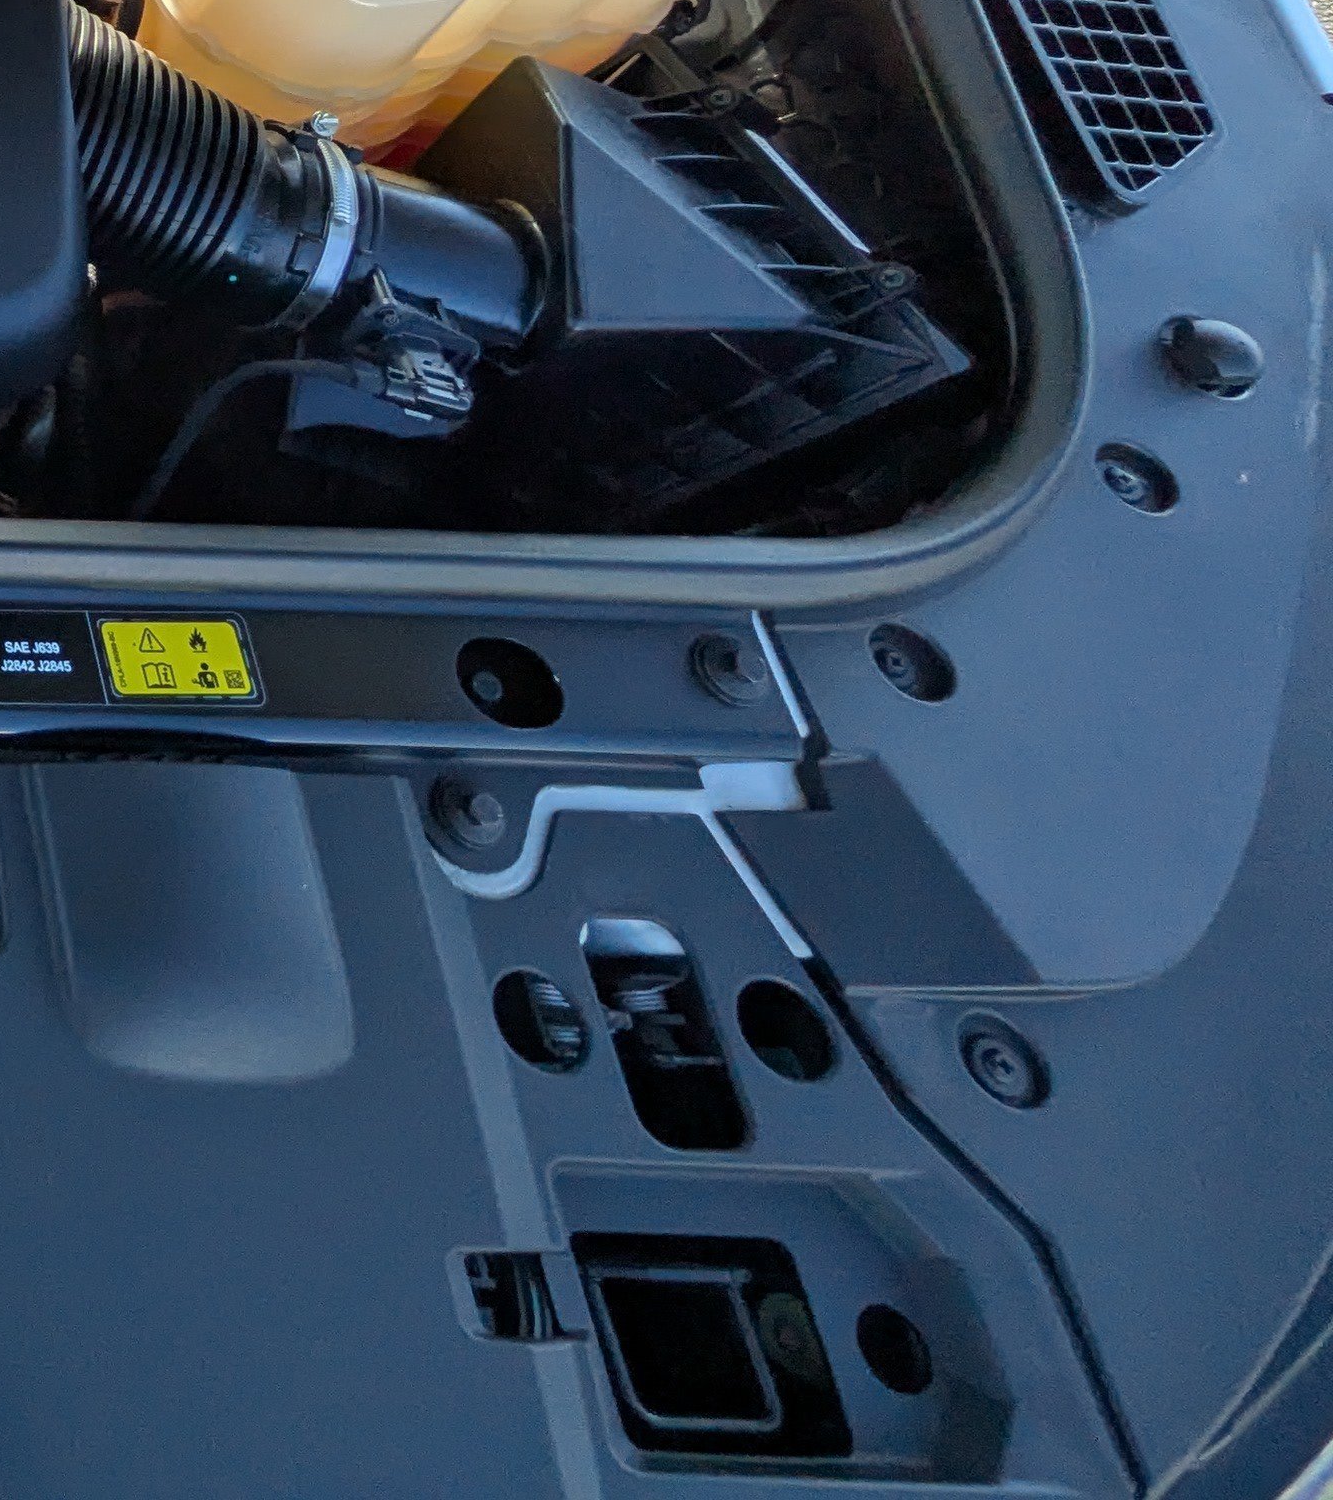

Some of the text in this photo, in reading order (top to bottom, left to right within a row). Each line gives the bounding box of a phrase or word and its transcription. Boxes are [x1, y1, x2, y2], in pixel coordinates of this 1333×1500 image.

[4, 641, 60, 654] SAE J639
[0, 659, 72, 673] J2842 J2845
